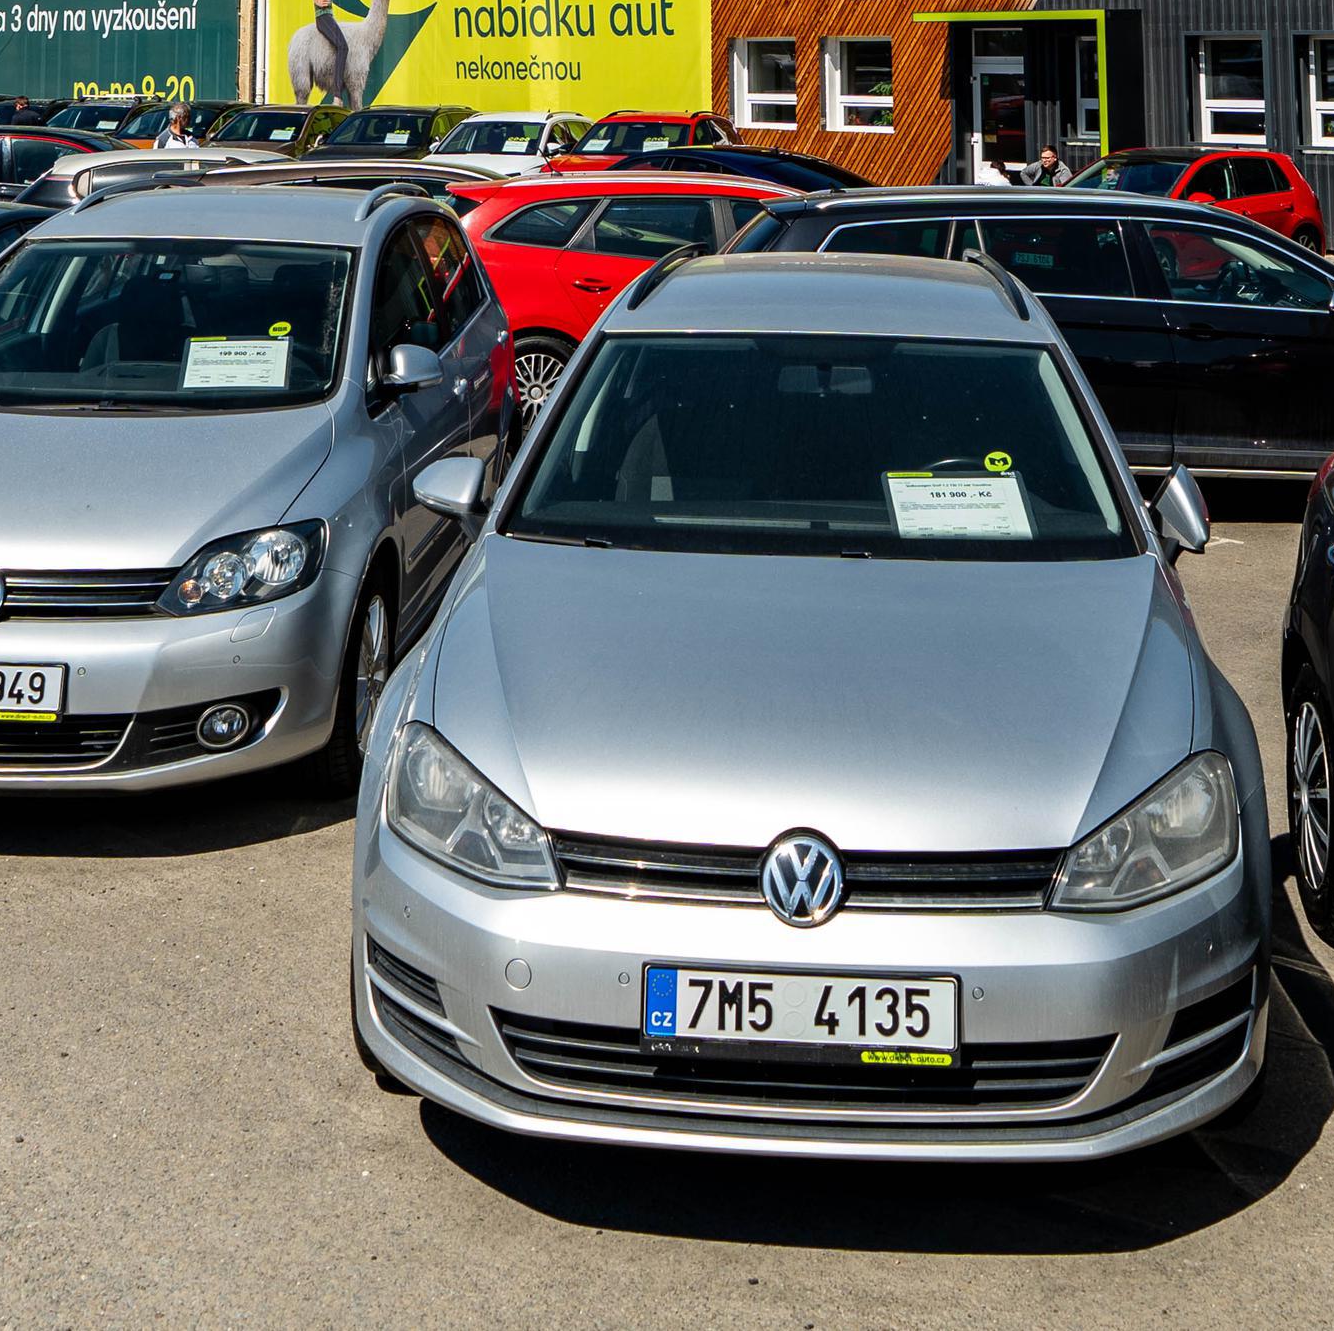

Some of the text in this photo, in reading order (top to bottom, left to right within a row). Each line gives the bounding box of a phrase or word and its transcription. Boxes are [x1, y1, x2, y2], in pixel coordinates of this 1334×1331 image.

[10, 4, 22, 32] 3
[26, 4, 58, 39] dny
[63, 8, 86, 31] na
[91, 0, 198, 38] vyzkoušení
[455, 55, 581, 81] nekonečnou
[979, 490, 992, 498] Kč
[651, 1010, 673, 1027] CZ
[687, 978, 931, 1039] 7M5 4135
